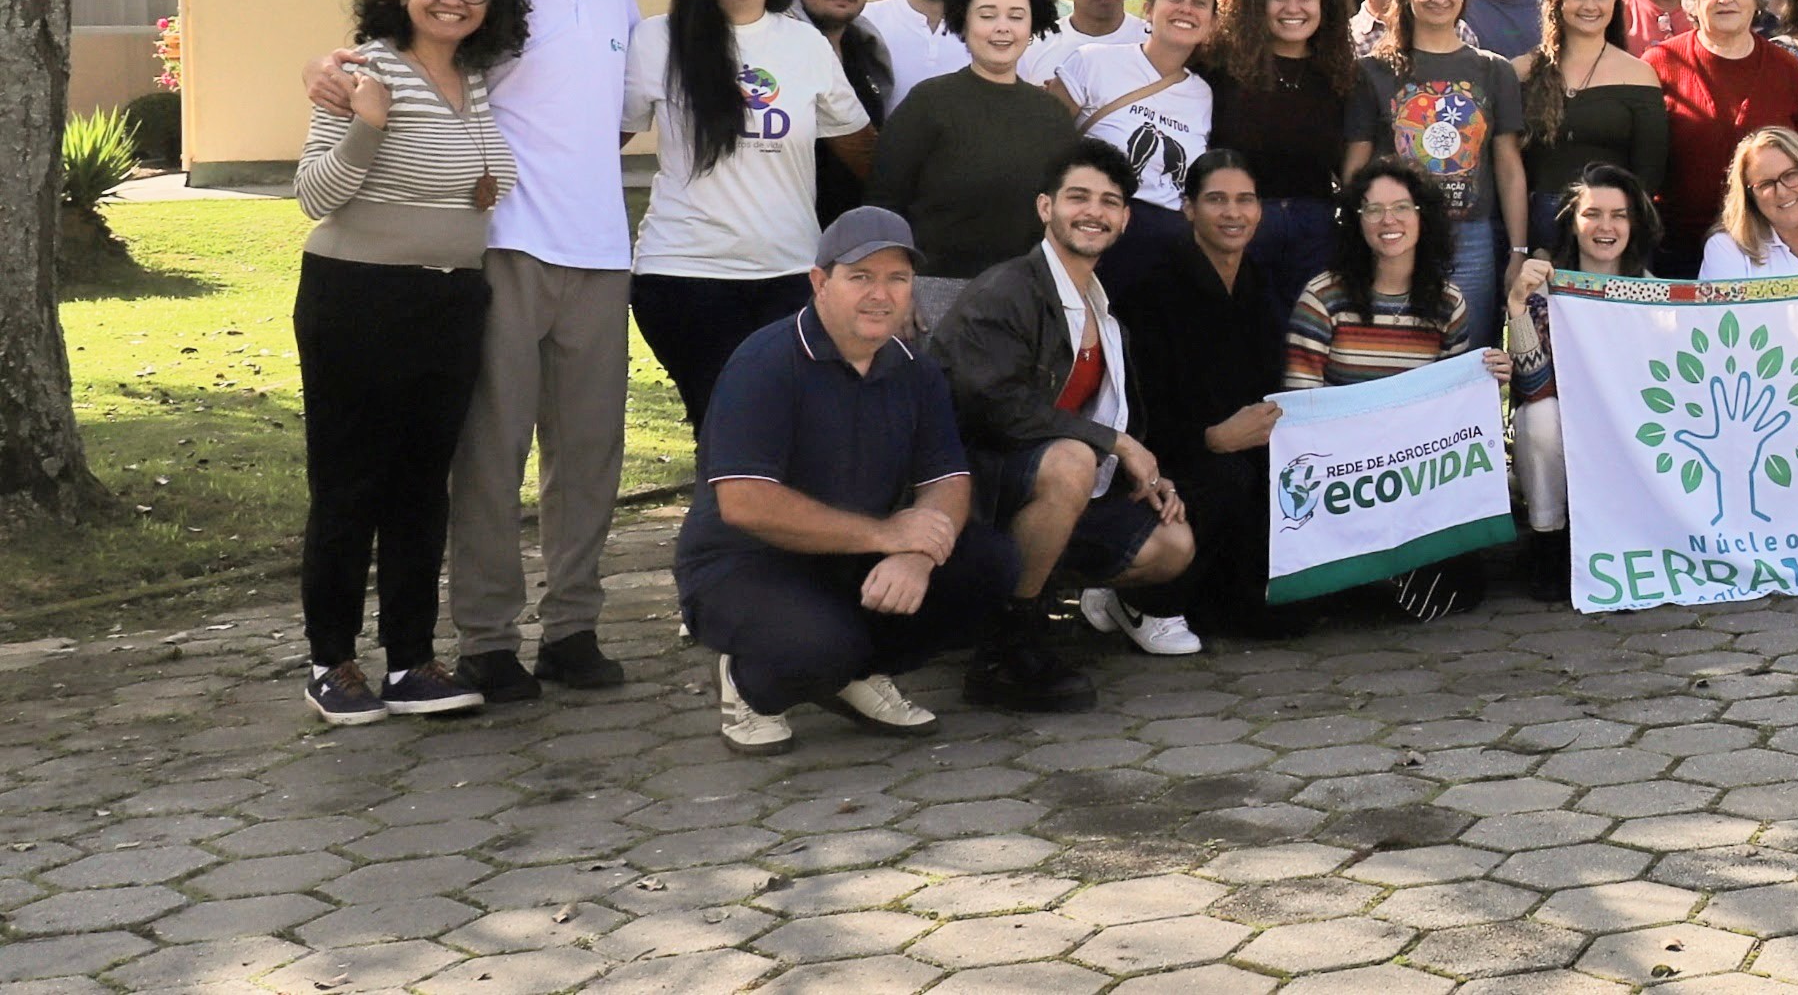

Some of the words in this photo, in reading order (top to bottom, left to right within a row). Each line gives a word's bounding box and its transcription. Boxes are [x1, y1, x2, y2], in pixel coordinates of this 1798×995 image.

[1129, 104, 1155, 121] APOIO
[1326, 460, 1363, 478] REDE
[1366, 456, 1384, 470] DE
[1387, 425, 1483, 466] AGROECOLOGIA
